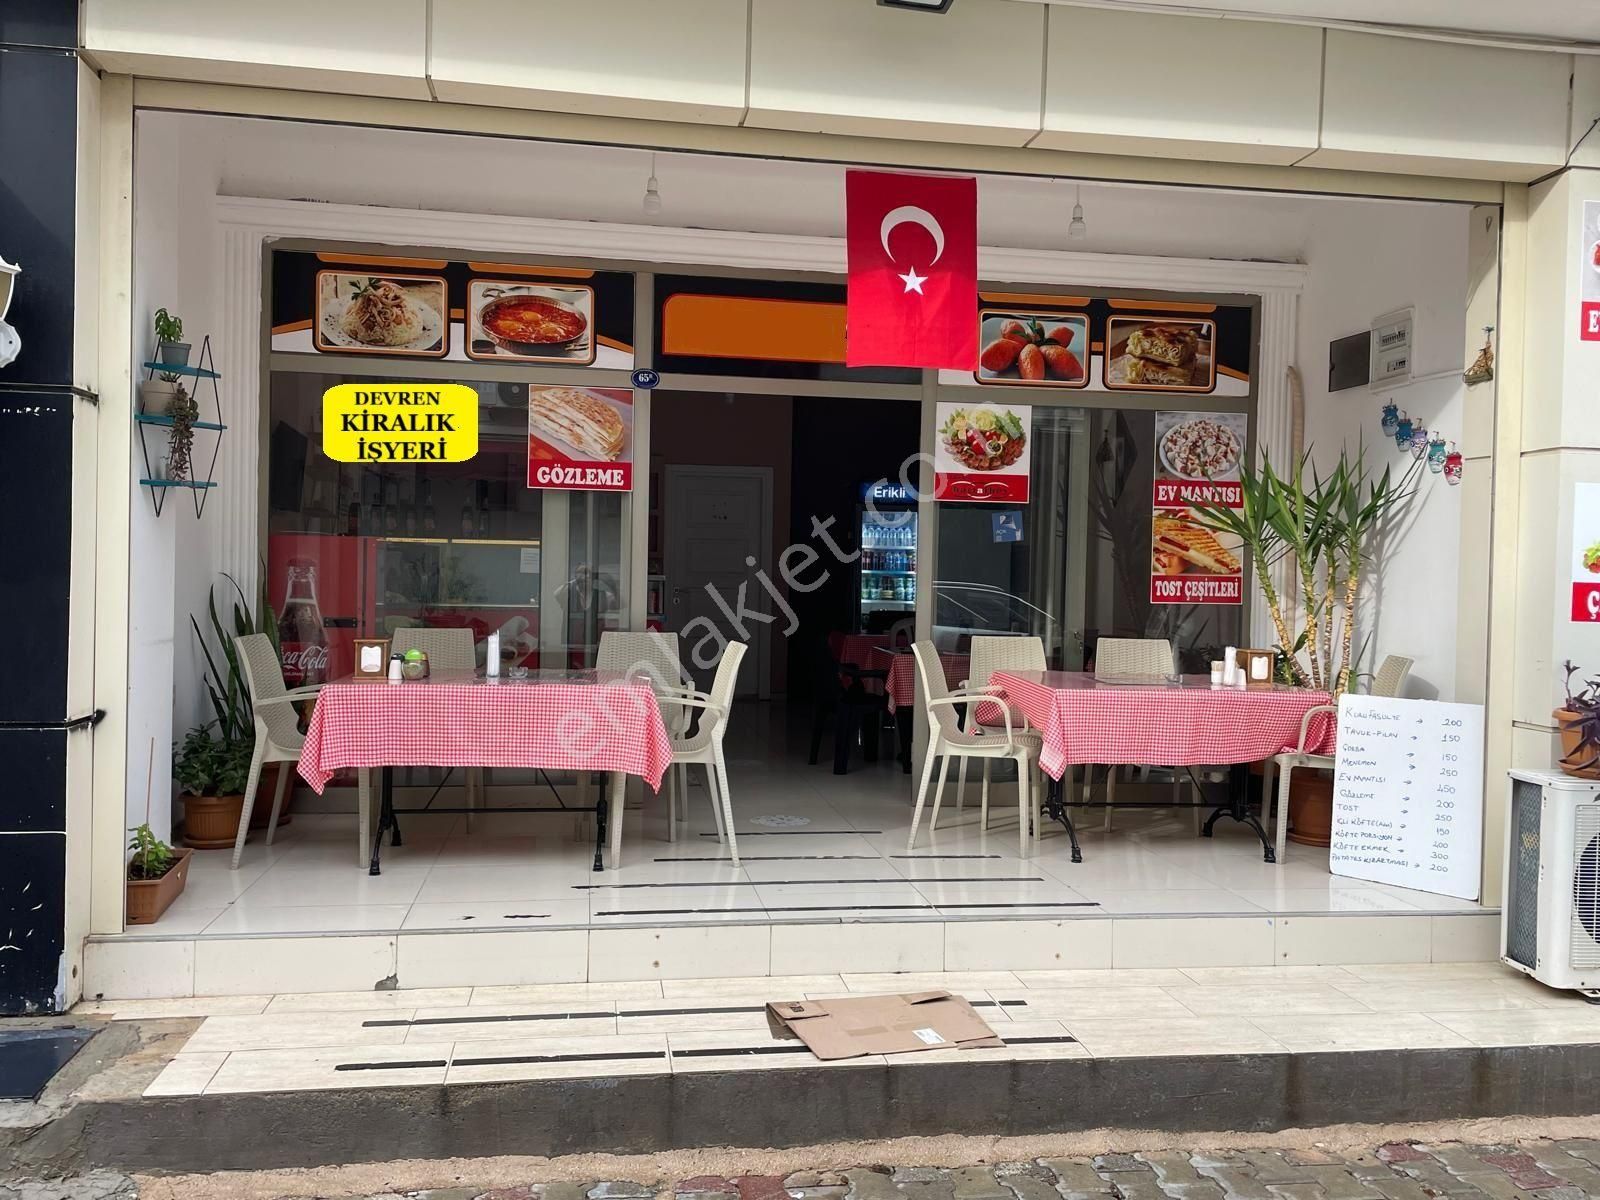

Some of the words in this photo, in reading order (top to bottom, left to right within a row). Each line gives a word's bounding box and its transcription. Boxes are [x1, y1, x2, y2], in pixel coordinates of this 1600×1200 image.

[1588, 310, 1600, 332] E
[537, 464, 624, 485] GÖZLEME
[874, 486, 906, 498] Erikli
[1158, 485, 1177, 501] EV
[1180, 486, 1241, 502] MANTISI
[1155, 581, 1182, 597] TOST
[1185, 578, 1239, 601] ÇEŞİTLERİ
[281, 645, 329, 670] ca-Cola
[1441, 718, 1462, 726] 200
[1441, 733, 1461, 742] 150
[1441, 754, 1457, 762] 150
[1439, 768, 1458, 777] 250
[1436, 800, 1454, 809] 200
[1336, 803, 1359, 812] TOST
[1434, 814, 1452, 822] 250
[1436, 827, 1450, 836] 150
[1430, 851, 1449, 860] 300
[1429, 863, 1448, 873] 200
